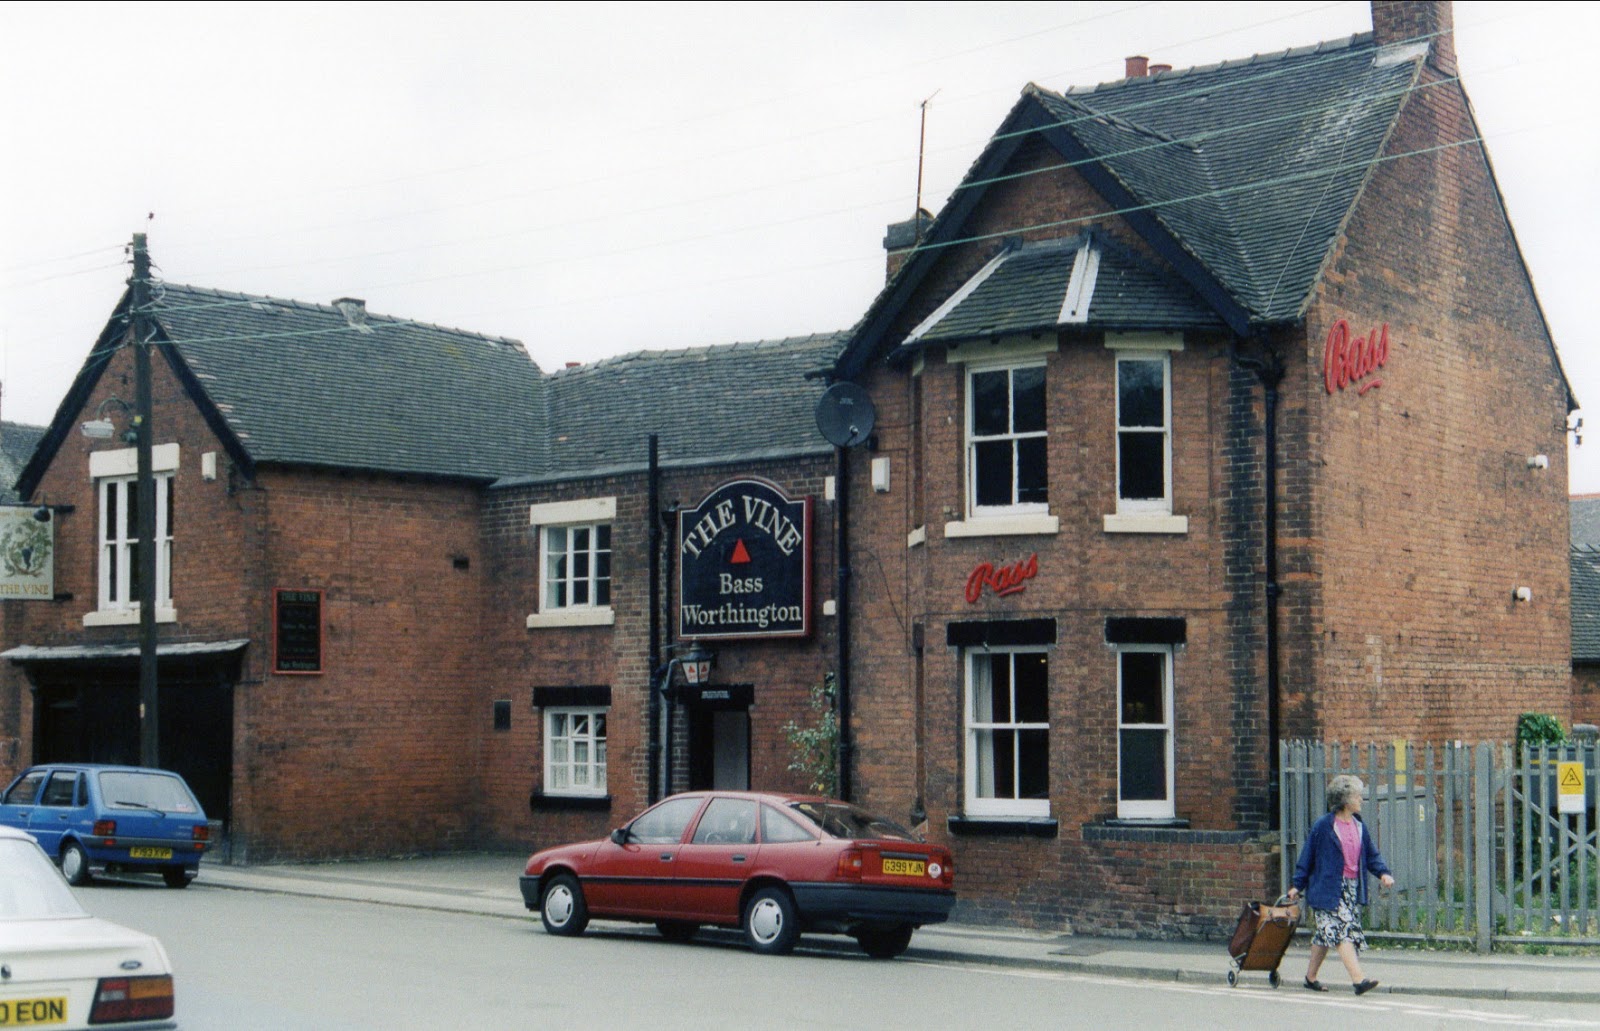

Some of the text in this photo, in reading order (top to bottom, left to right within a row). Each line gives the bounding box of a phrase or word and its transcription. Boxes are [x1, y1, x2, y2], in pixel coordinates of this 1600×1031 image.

[1324, 319, 1389, 395] Bass
[682, 495, 801, 559] THE VINE
[719, 573, 763, 594] Bass
[965, 552, 1038, 603] Bass
[0, 584, 48, 595] THE VINE
[682, 603, 801, 627] Worthington
[885, 861, 924, 872] G399 YJN
[16, 1000, 64, 1022] EON
